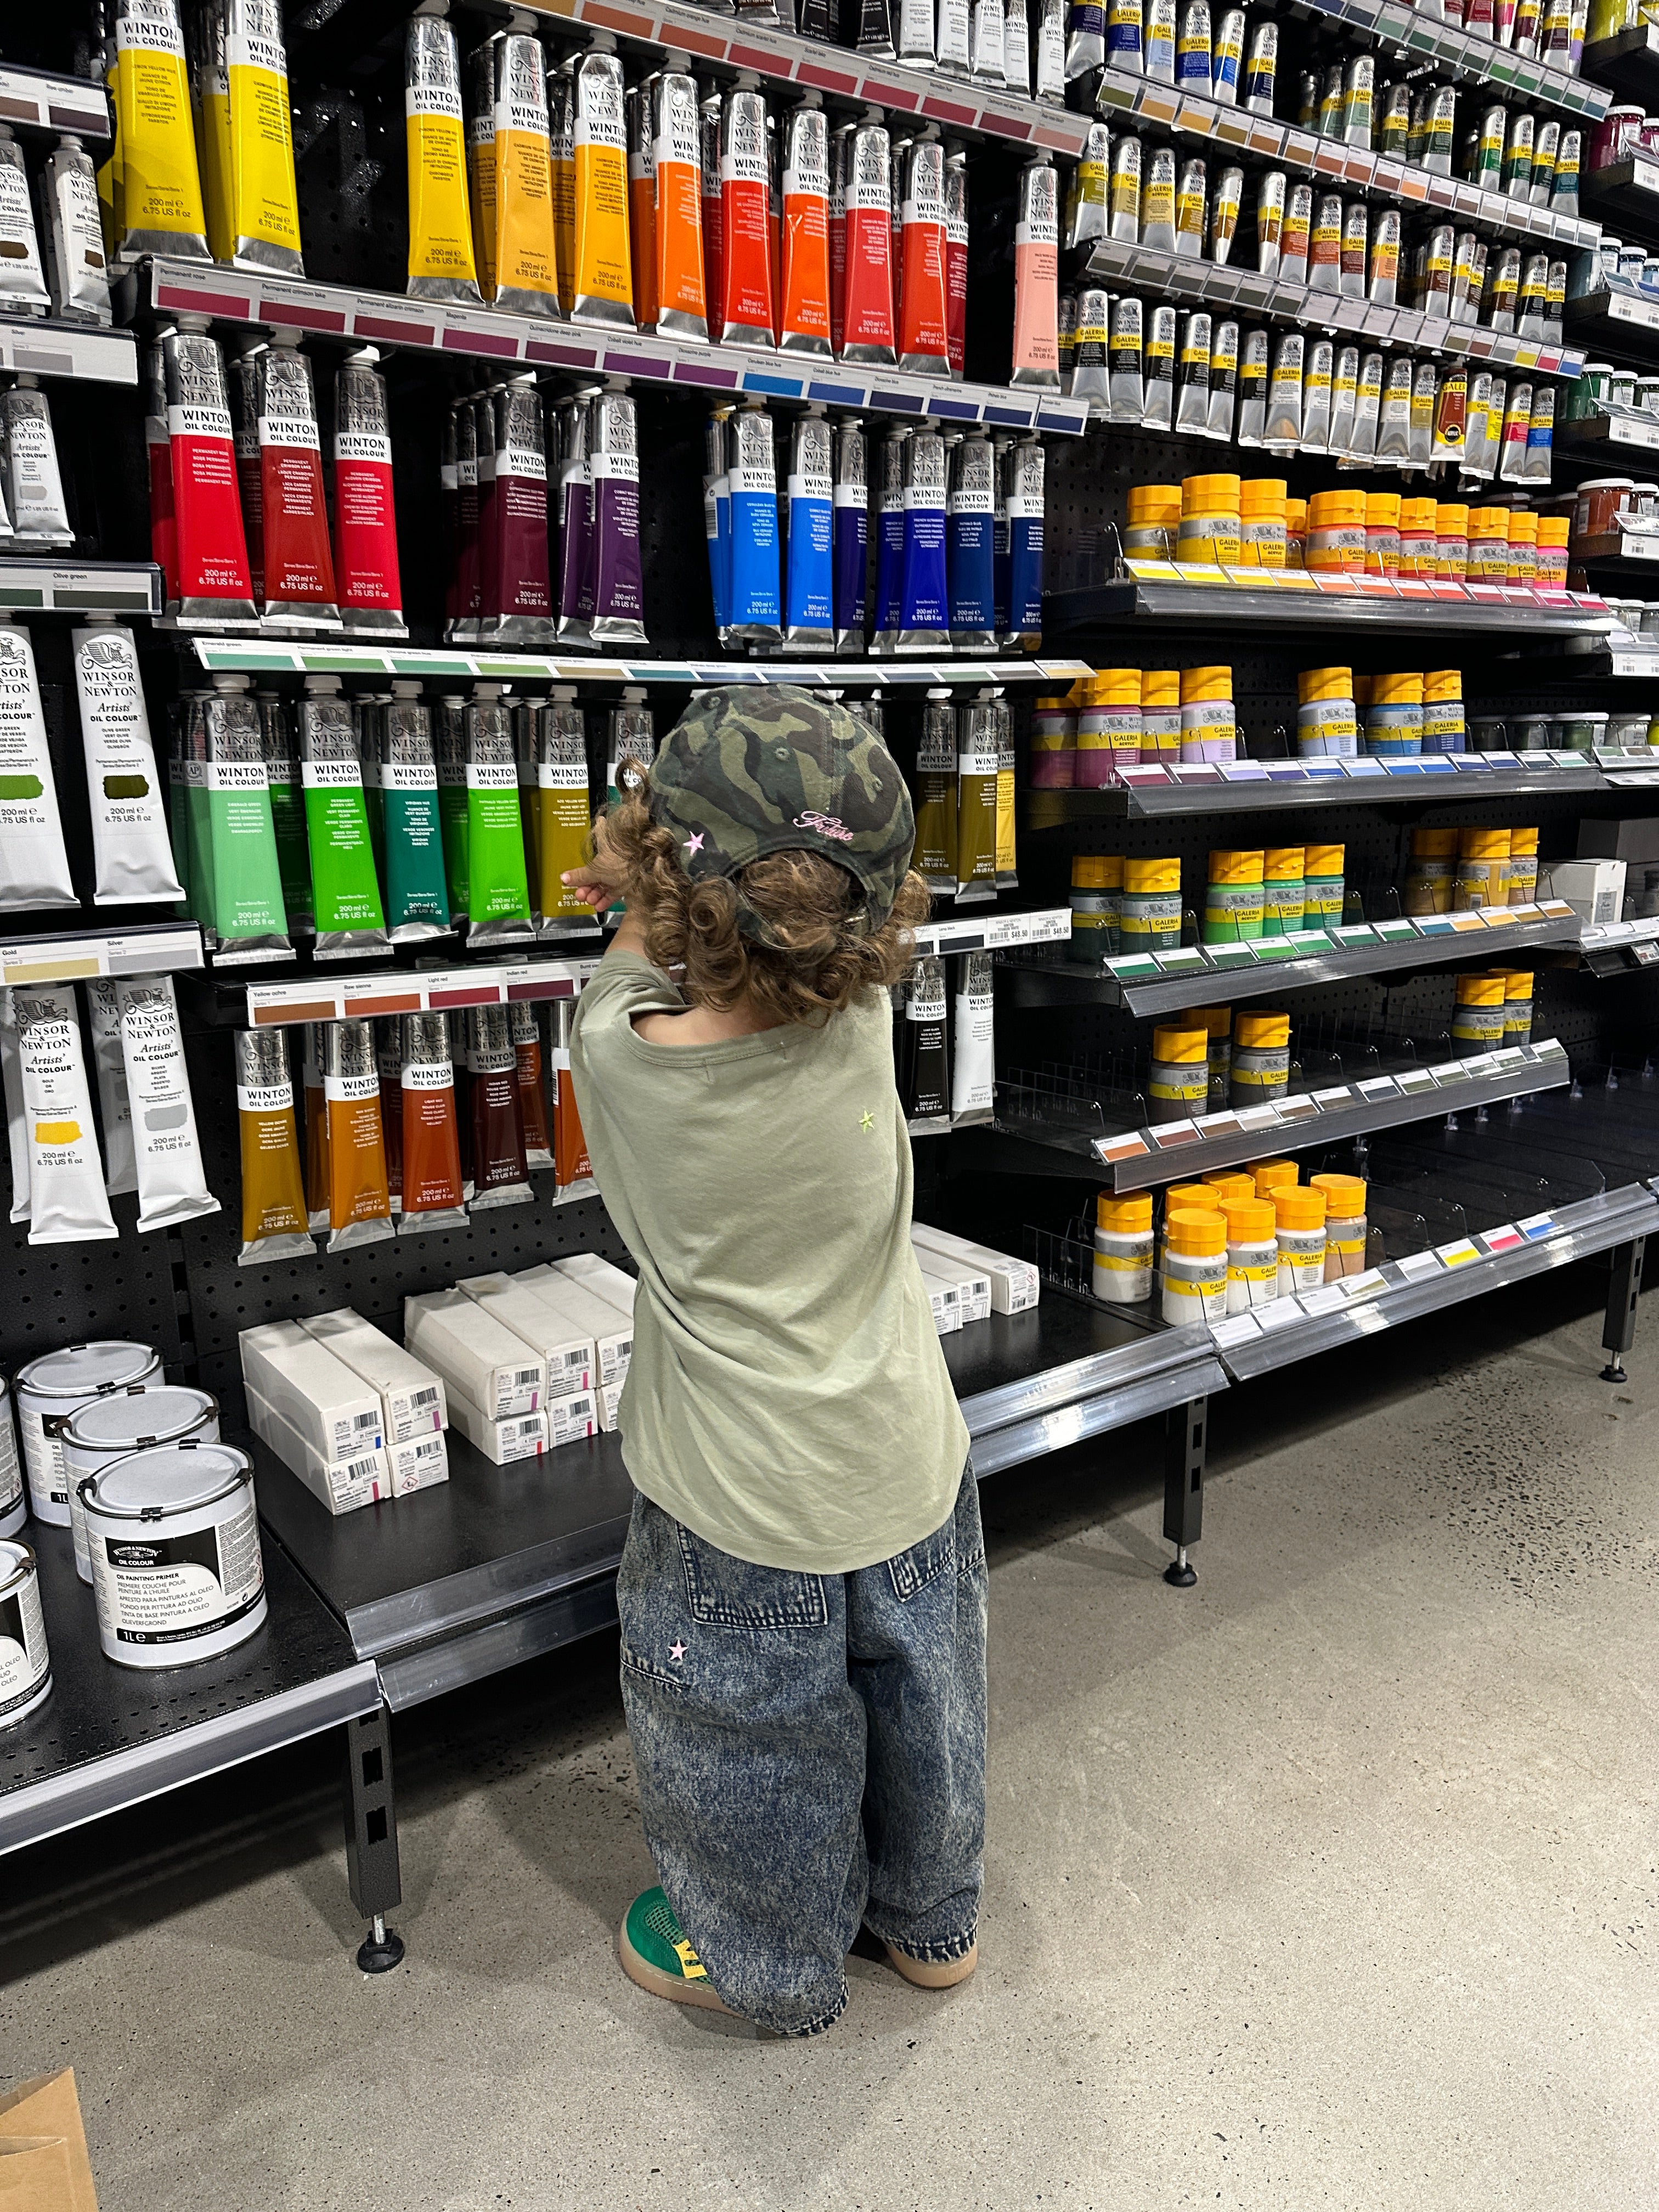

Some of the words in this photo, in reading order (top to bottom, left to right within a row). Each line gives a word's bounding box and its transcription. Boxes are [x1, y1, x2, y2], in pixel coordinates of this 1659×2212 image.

[124, 22, 177, 41] WINTON
[414, 89, 459, 106] WINTON
[148, 198, 164, 207] 200
[143, 206, 161, 215] 6.75
[162, 207, 174, 216] US
[181, 411, 230, 425] WINTON
[268, 422, 315, 436] WINTON
[287, 435, 317, 444] COLOUR
[340, 438, 385, 449] WINTON
[354, 449, 385, 458] COLOUR
[510, 454, 545, 467] WINTON
[82, 672, 134, 683] WINSOR
[84, 686, 137, 698] NEWTON
[217, 768, 264, 777] WINTON
[314, 765, 359, 775] WINTON
[393, 768, 435, 777] WINTON
[477, 768, 515, 777] WINTON
[551, 769, 587, 777] WINTON
[126, 1012, 174, 1026] WINSOR
[20, 1025, 69, 1036] WINSOR
[128, 1026, 176, 1040] NEWTON
[20, 1039, 71, 1051] NEWTON
[148, 1051, 178, 1060] COLOUR
[477, 1052, 514, 1063] WINTON
[38, 1065, 72, 1074] COLOUR
[411, 1068, 450, 1079] WINTON
[247, 1088, 290, 1099] WINTON
[264, 1097, 290, 1106] COLOUR
[198, 1585, 214, 1594] OLEO
[160, 1609, 187, 1617] PINTURA
[194, 1603, 210, 1611] OLEO
[123, 1631, 135, 1641] 1L
[5, 1656, 20, 1667] OLEO
[1, 1675, 18, 1686] OLEO
